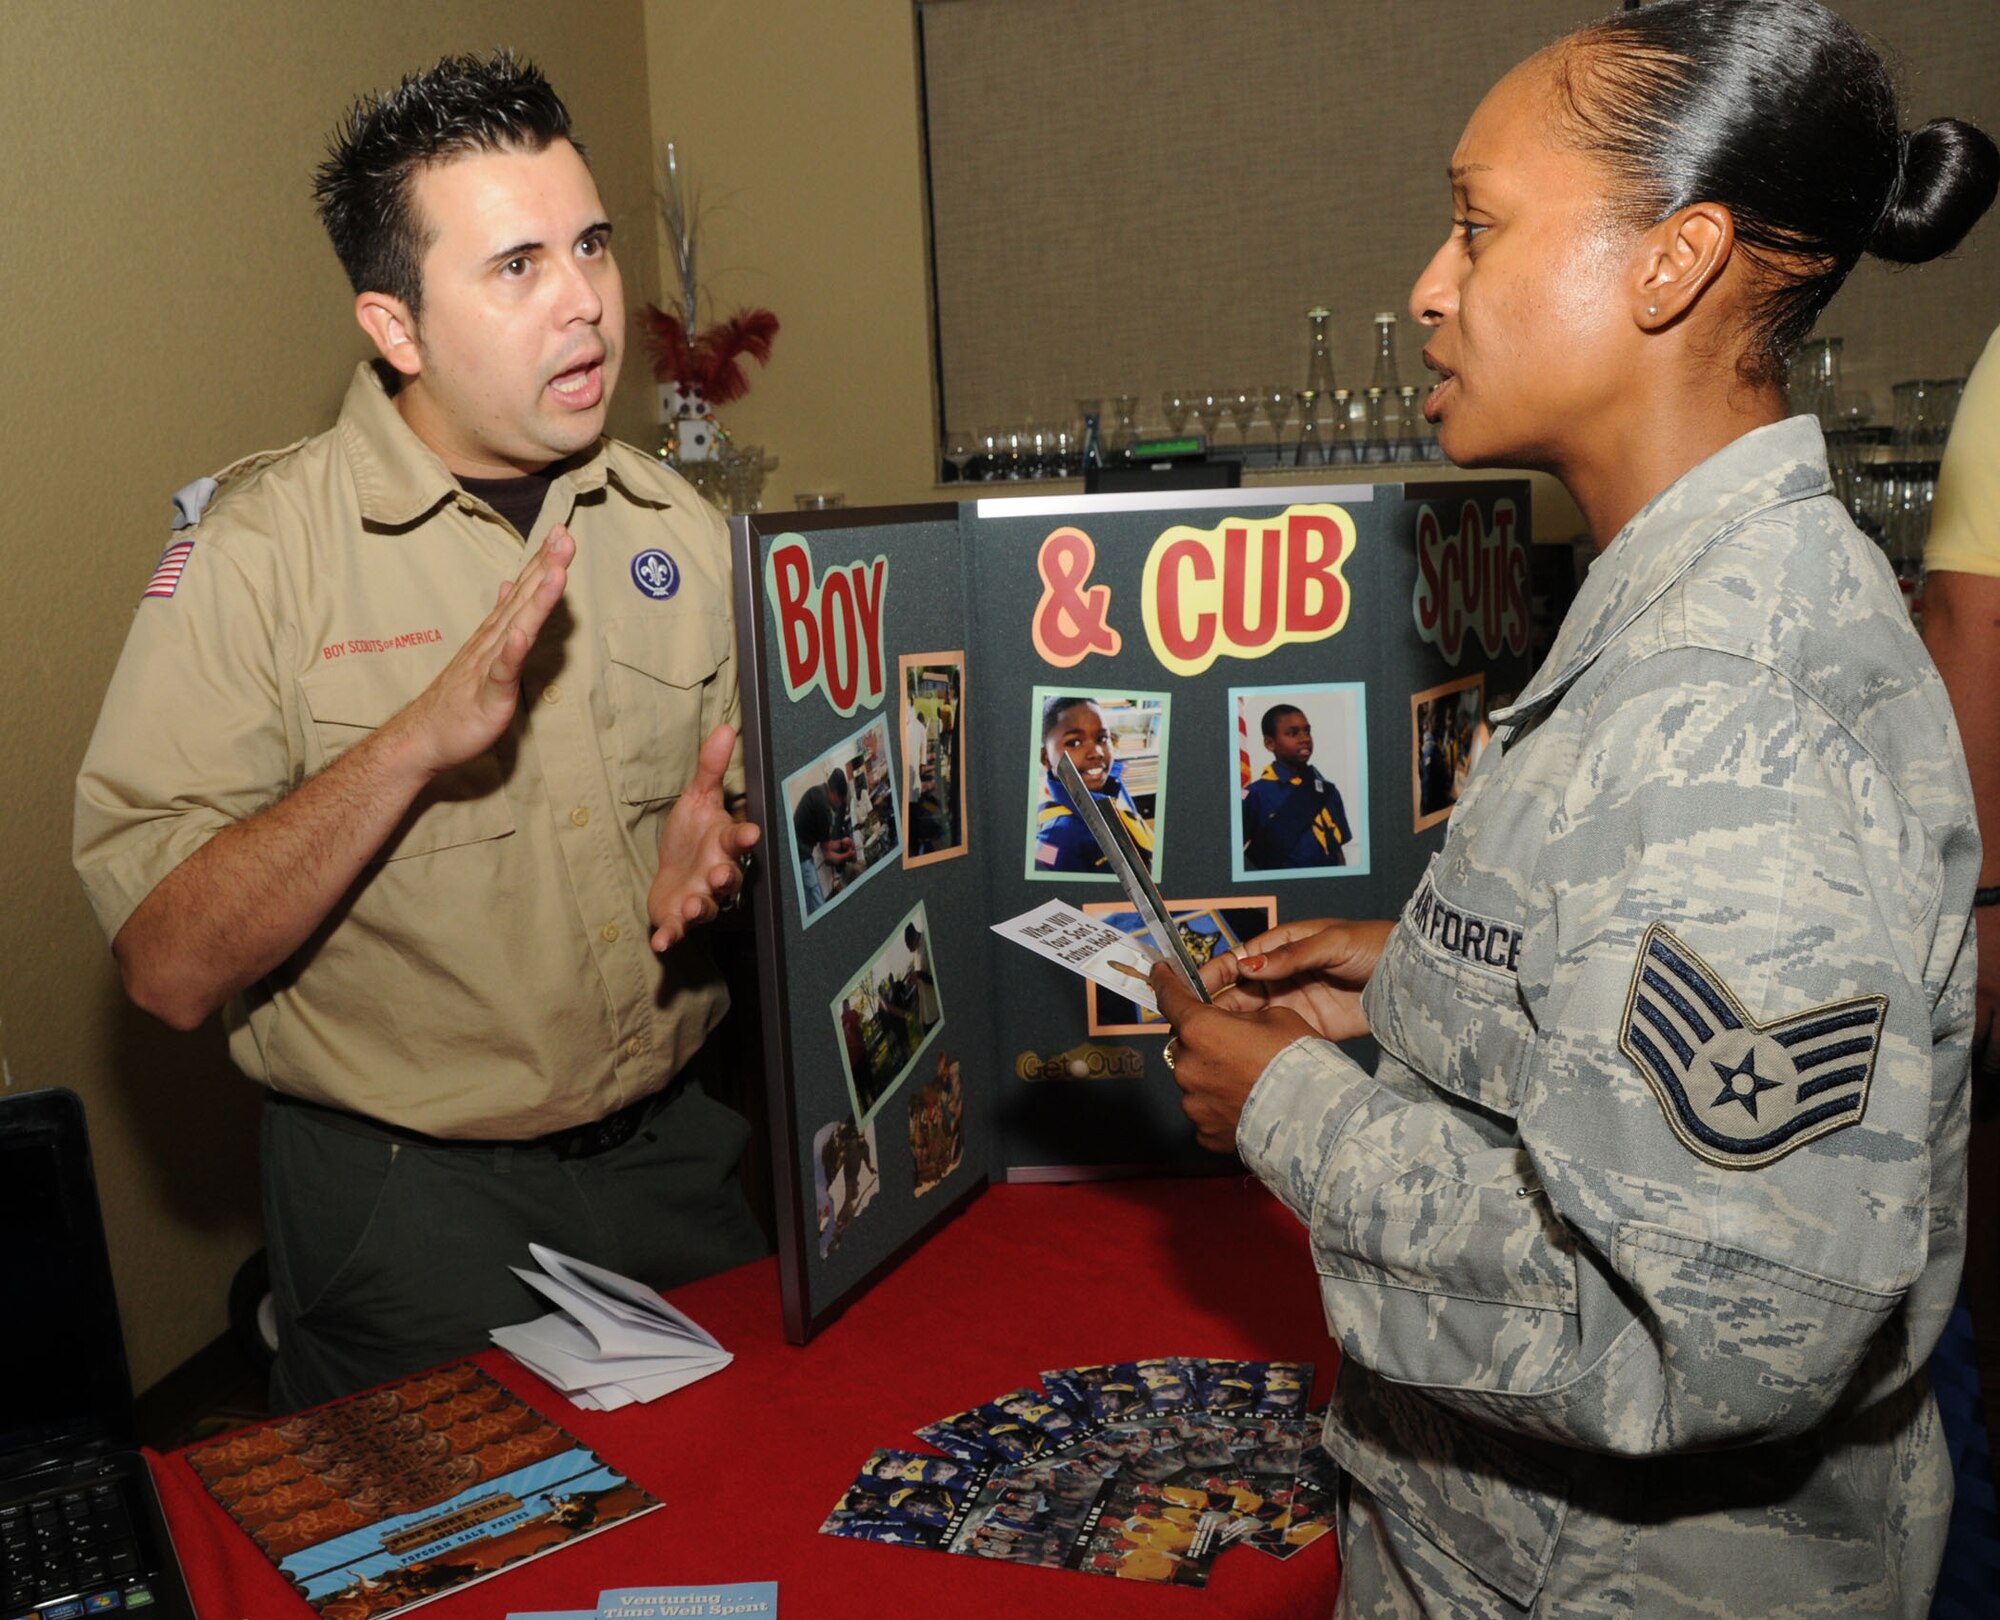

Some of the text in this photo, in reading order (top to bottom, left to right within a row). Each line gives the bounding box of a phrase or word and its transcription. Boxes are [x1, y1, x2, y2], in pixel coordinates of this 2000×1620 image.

[773, 502, 1526, 710] BOY & CUB SCOUTS
[323, 643, 345, 660] BOY
[348, 639, 384, 653] SCOUTS
[394, 629, 443, 648] AMERICA
[1019, 912, 1077, 939] What Will
[1039, 922, 1098, 950] Your Son's
[1429, 903, 1523, 972] FORCE
[1057, 929, 1122, 963] Future Hold?
[1086, 1051, 1143, 1076] Out
[939, 1515, 964, 1545] THERE
[959, 1501, 971, 1513] IS
[966, 1485, 980, 1499] NO
[401, 1511, 531, 1565] POPCORN SALE PRIZES
[1076, 1535, 1090, 1546] IN
[603, 1601, 769, 1619] Time Well Spent
[620, 1593, 722, 1605] Venturing
